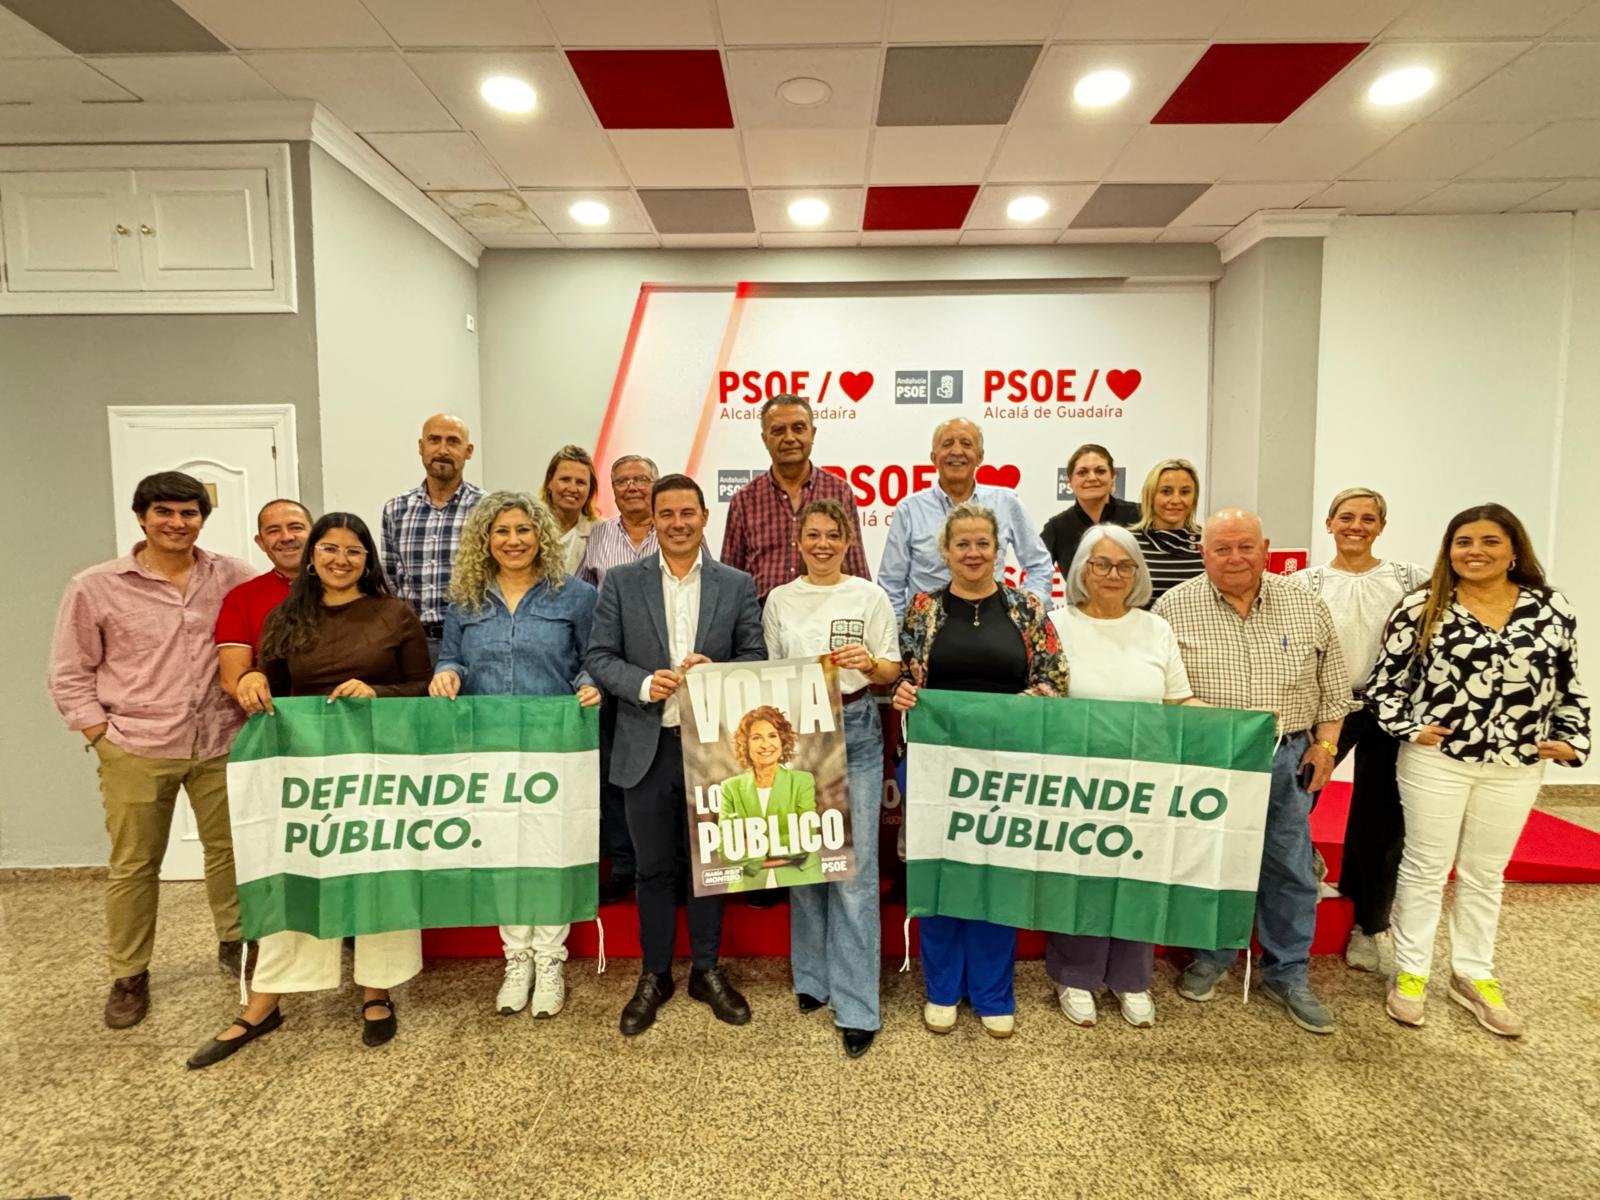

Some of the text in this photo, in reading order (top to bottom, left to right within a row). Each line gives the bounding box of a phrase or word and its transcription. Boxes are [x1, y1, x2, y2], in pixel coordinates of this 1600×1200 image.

[719, 371, 810, 404] PSOE
[896, 386, 927, 398] PSOE
[984, 369, 1077, 403] PSOE
[813, 406, 857, 420] adaíra
[984, 404, 1123, 419] Alcalá de Guadaíra
[720, 484, 742, 497] PSO
[685, 663, 836, 744] VOTA
[281, 771, 559, 810] DEFIENDE LO
[695, 784, 721, 815] LO
[948, 767, 1155, 814] DEFIENDE
[1167, 785, 1229, 821] LO
[284, 813, 482, 858] PÚBLICO.
[698, 808, 845, 865] PÚBLICO
[947, 804, 1143, 860] PÚBLICO.
[821, 861, 847, 873] PSOE
